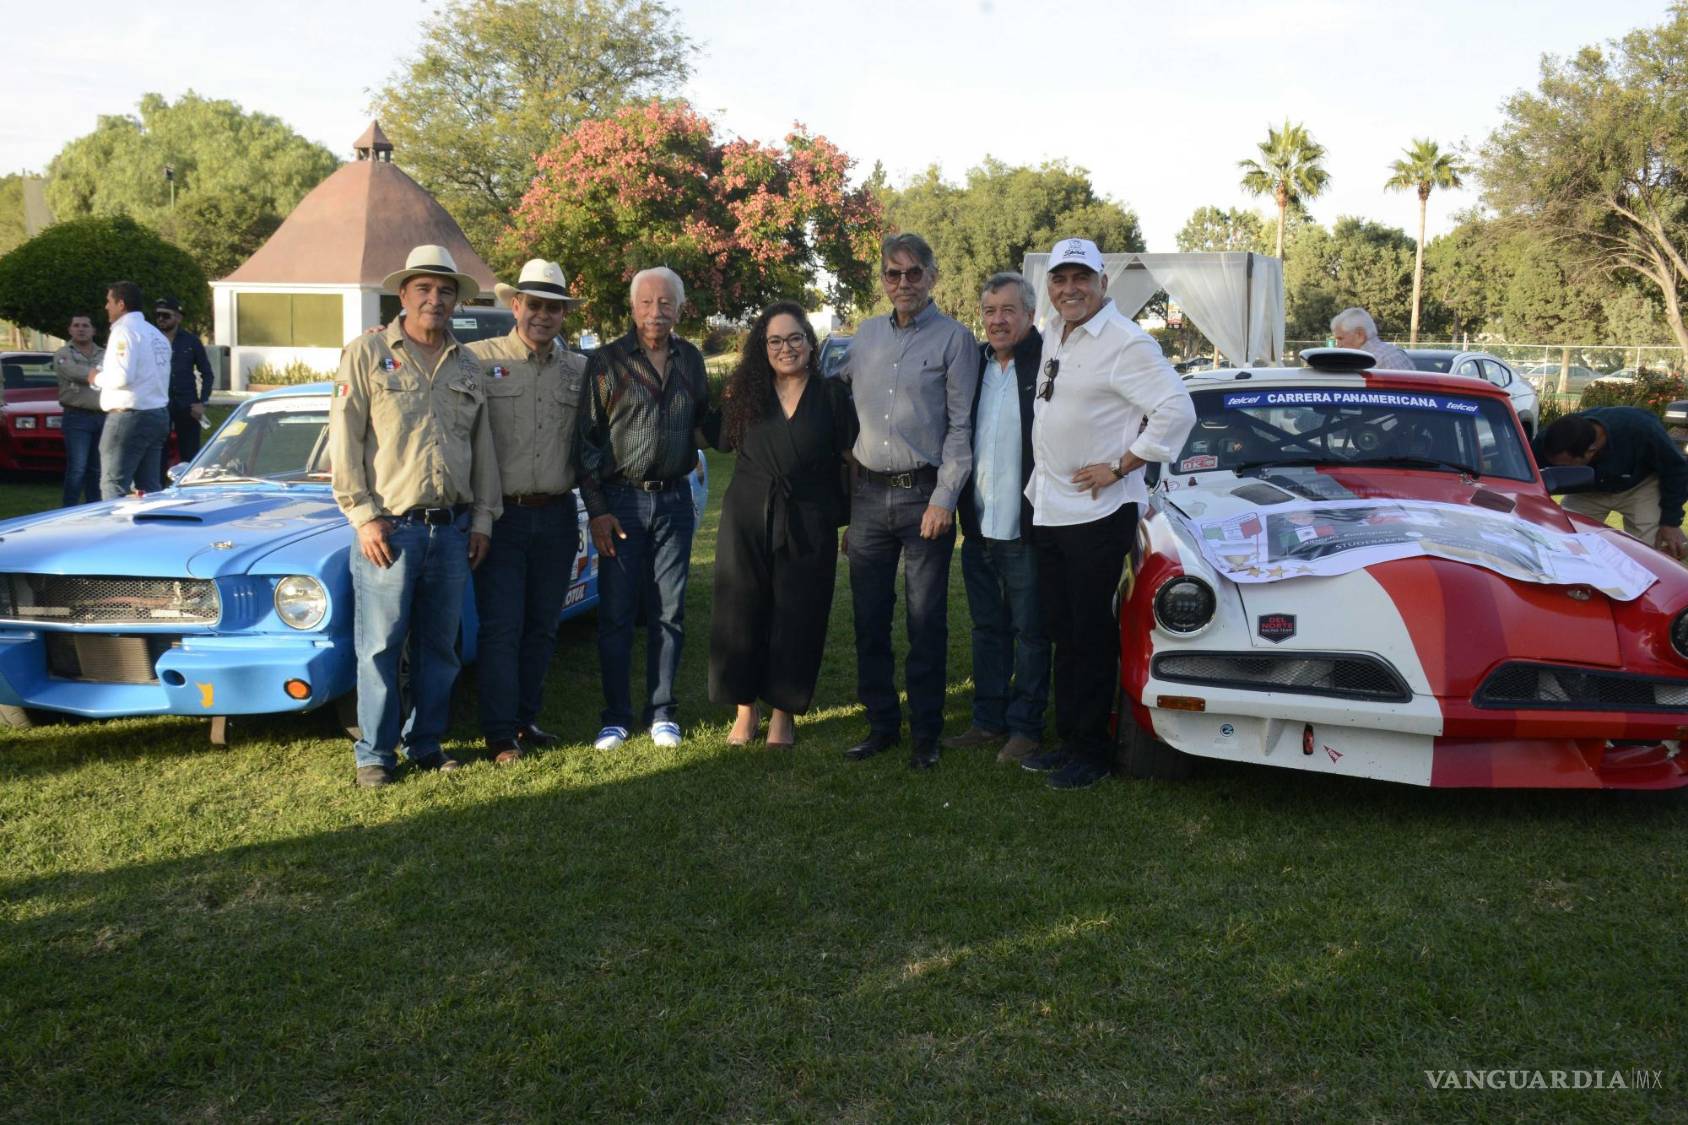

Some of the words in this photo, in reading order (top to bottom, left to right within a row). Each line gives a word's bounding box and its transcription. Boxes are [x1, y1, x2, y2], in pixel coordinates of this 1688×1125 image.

[1228, 395, 1262, 405] telcel
[1267, 391, 1332, 404] CARRERA
[1333, 391, 1438, 408] PANAMERICANA
[1446, 402, 1479, 412] telcel
